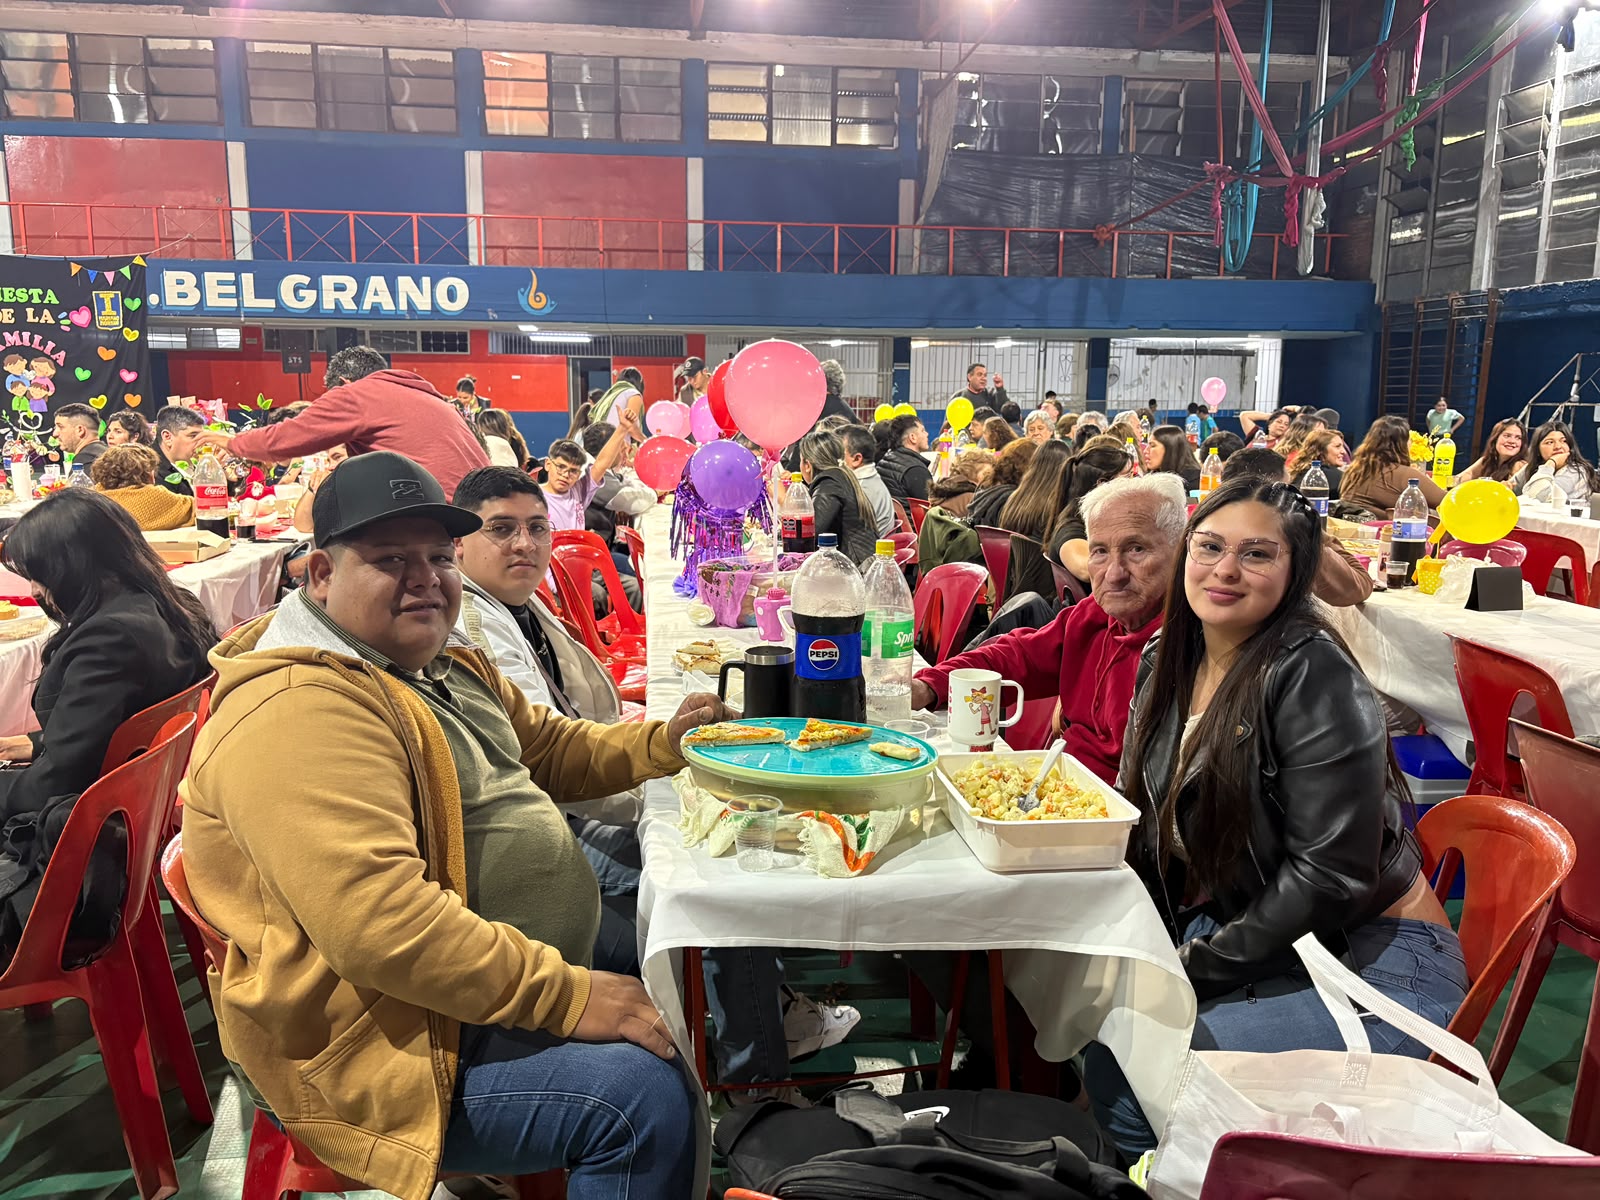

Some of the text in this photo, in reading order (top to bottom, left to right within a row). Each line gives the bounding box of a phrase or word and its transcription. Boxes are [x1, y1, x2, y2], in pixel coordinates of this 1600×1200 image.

[0, 287, 60, 304] ESTA
[0, 307, 55, 324] E LA
[0, 330, 66, 367] MILIA
[809, 650, 838, 658] PEPSI
